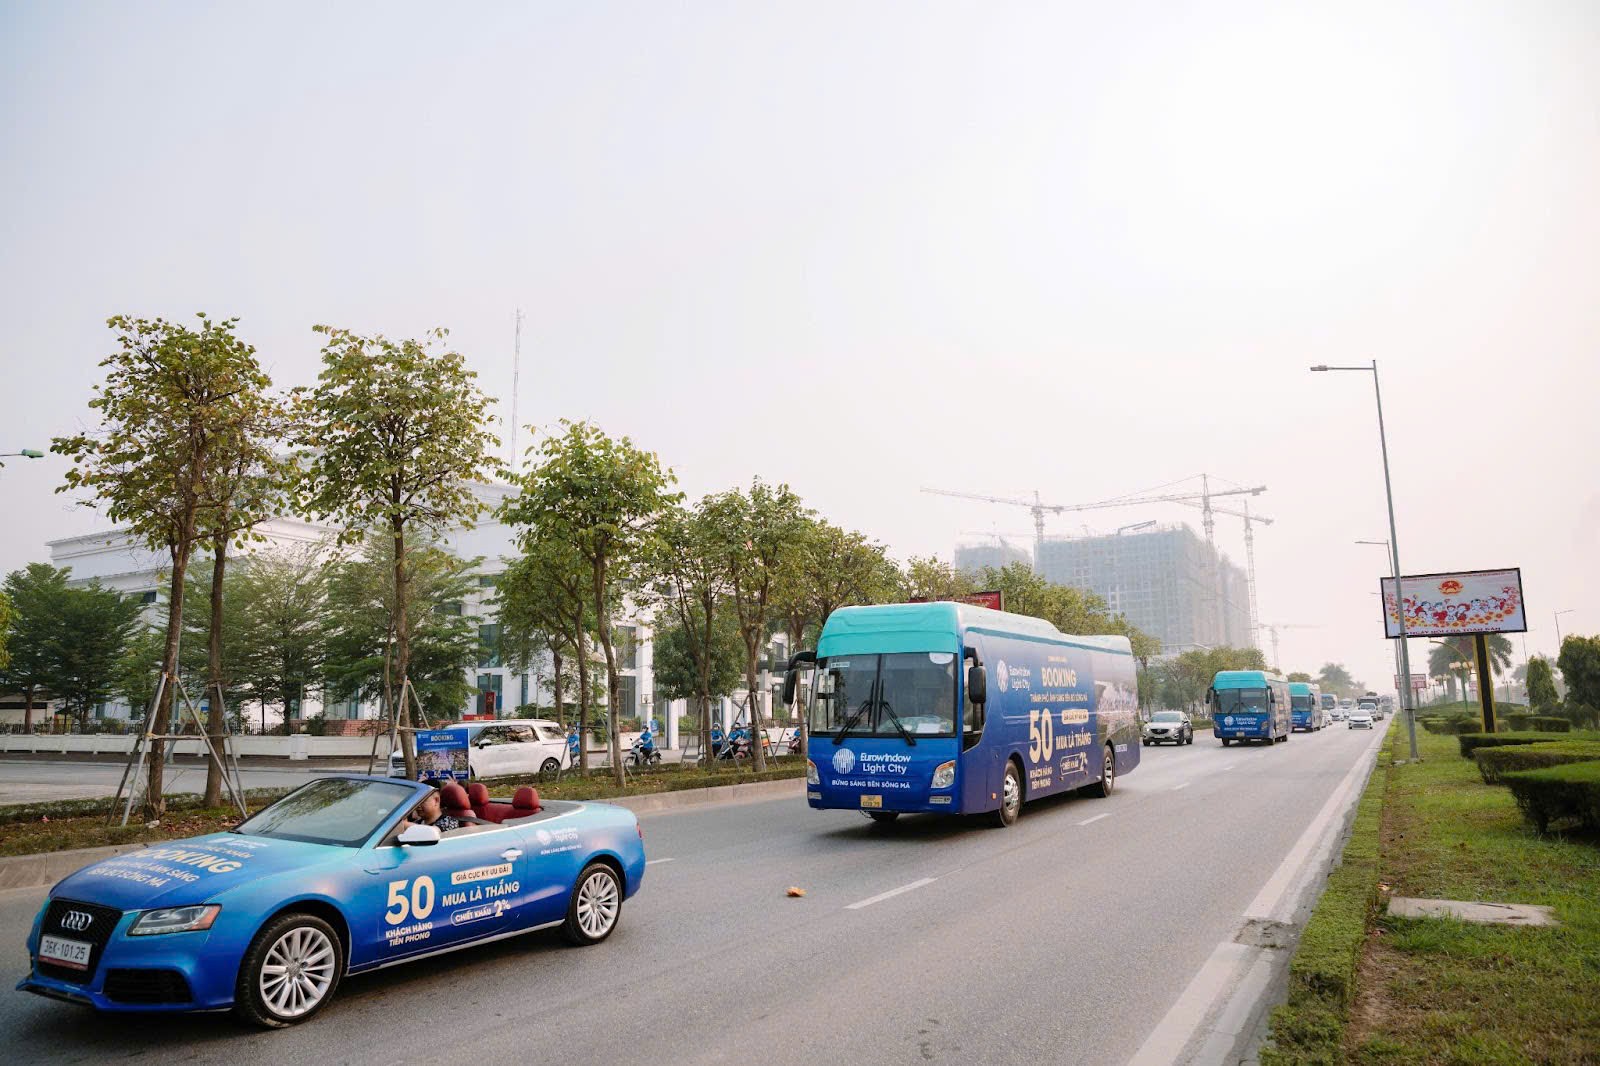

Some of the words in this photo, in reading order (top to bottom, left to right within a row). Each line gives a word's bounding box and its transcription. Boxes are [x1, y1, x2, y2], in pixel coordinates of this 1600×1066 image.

[1041, 667, 1077, 688] BOOKING
[1029, 708, 1053, 764] 50
[1056, 735, 1068, 750] MUA
[1068, 731, 1075, 748] LÀ
[860, 752, 911, 762] Eurowindow
[862, 763, 886, 773] Light
[888, 763, 907, 775] City
[456, 873, 467, 881] GIÁ
[385, 875, 435, 925] 50
[442, 891, 467, 907] MUA
[469, 885, 482, 902] LÀ
[485, 878, 520, 898] THẮNG
[455, 908, 473, 922] CHIẾT
[474, 904, 492, 918] KHẤU
[493, 899, 511, 918] 2%
[386, 924, 412, 939] KHÁCH
[413, 920, 433, 934] HÀNG
[405, 931, 431, 944] PHONG
